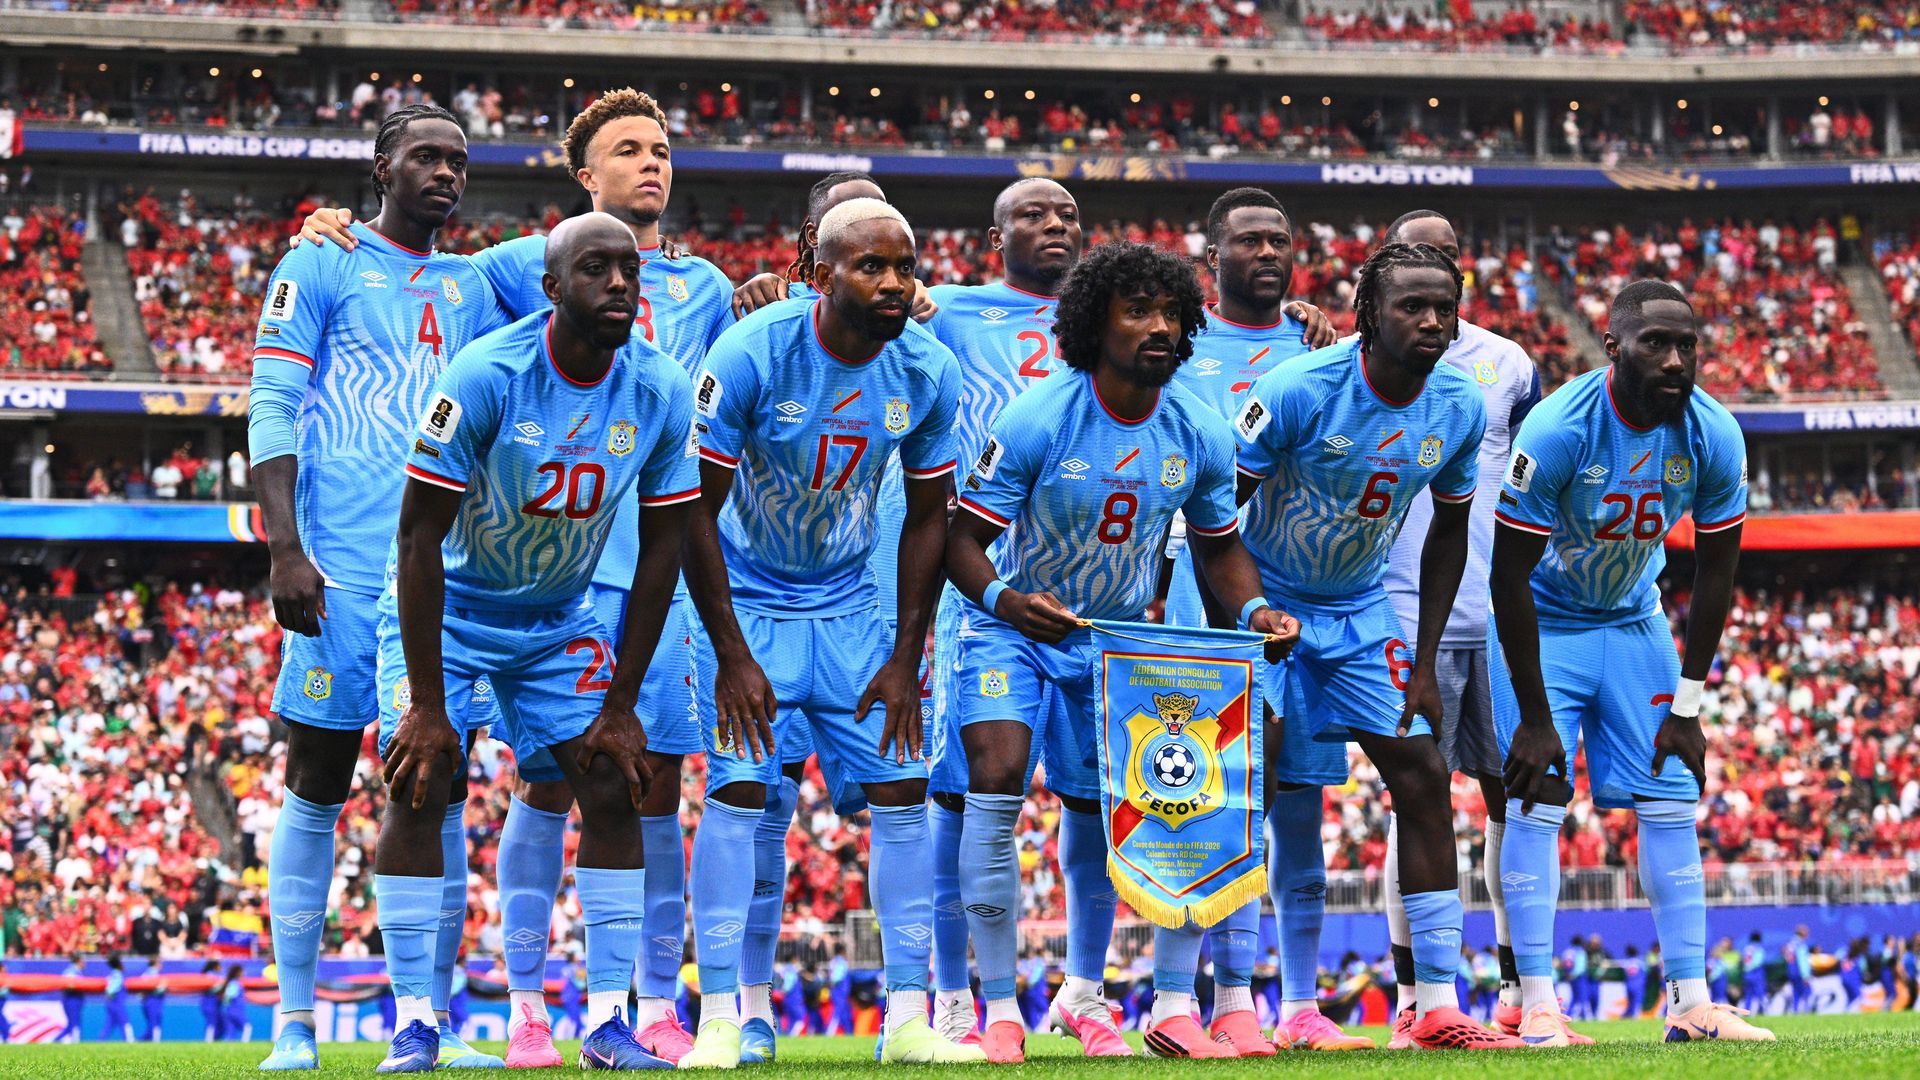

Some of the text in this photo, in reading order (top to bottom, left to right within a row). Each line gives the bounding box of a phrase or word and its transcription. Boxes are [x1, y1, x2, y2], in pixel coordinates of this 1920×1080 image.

[139, 134, 185, 154] FIFA
[186, 135, 262, 156] WORLD
[264, 137, 306, 157] CUP
[1321, 164, 1473, 185] HOUSTON
[1850, 163, 1896, 184] FIFA
[418, 301, 442, 356] 4
[776, 415, 803, 424] umbro
[1804, 406, 1853, 430] FIFA
[514, 435, 540, 447] umbro
[1324, 447, 1349, 456] umbro
[811, 434, 869, 491] 17
[1060, 473, 1087, 481] umbro
[521, 462, 606, 520] 20
[1357, 471, 1399, 519] 6
[1098, 492, 1138, 545] 8
[1594, 492, 1663, 541] 26
[1133, 663, 1220, 679] FÉDÉRATION CONGOLAISE
[1385, 639, 1414, 691] 6
[1129, 676, 1222, 690] DE FOOTBALL ASSOCIATION
[1139, 790, 1211, 815] FECOFA
[1189, 851, 1208, 860] Congo
